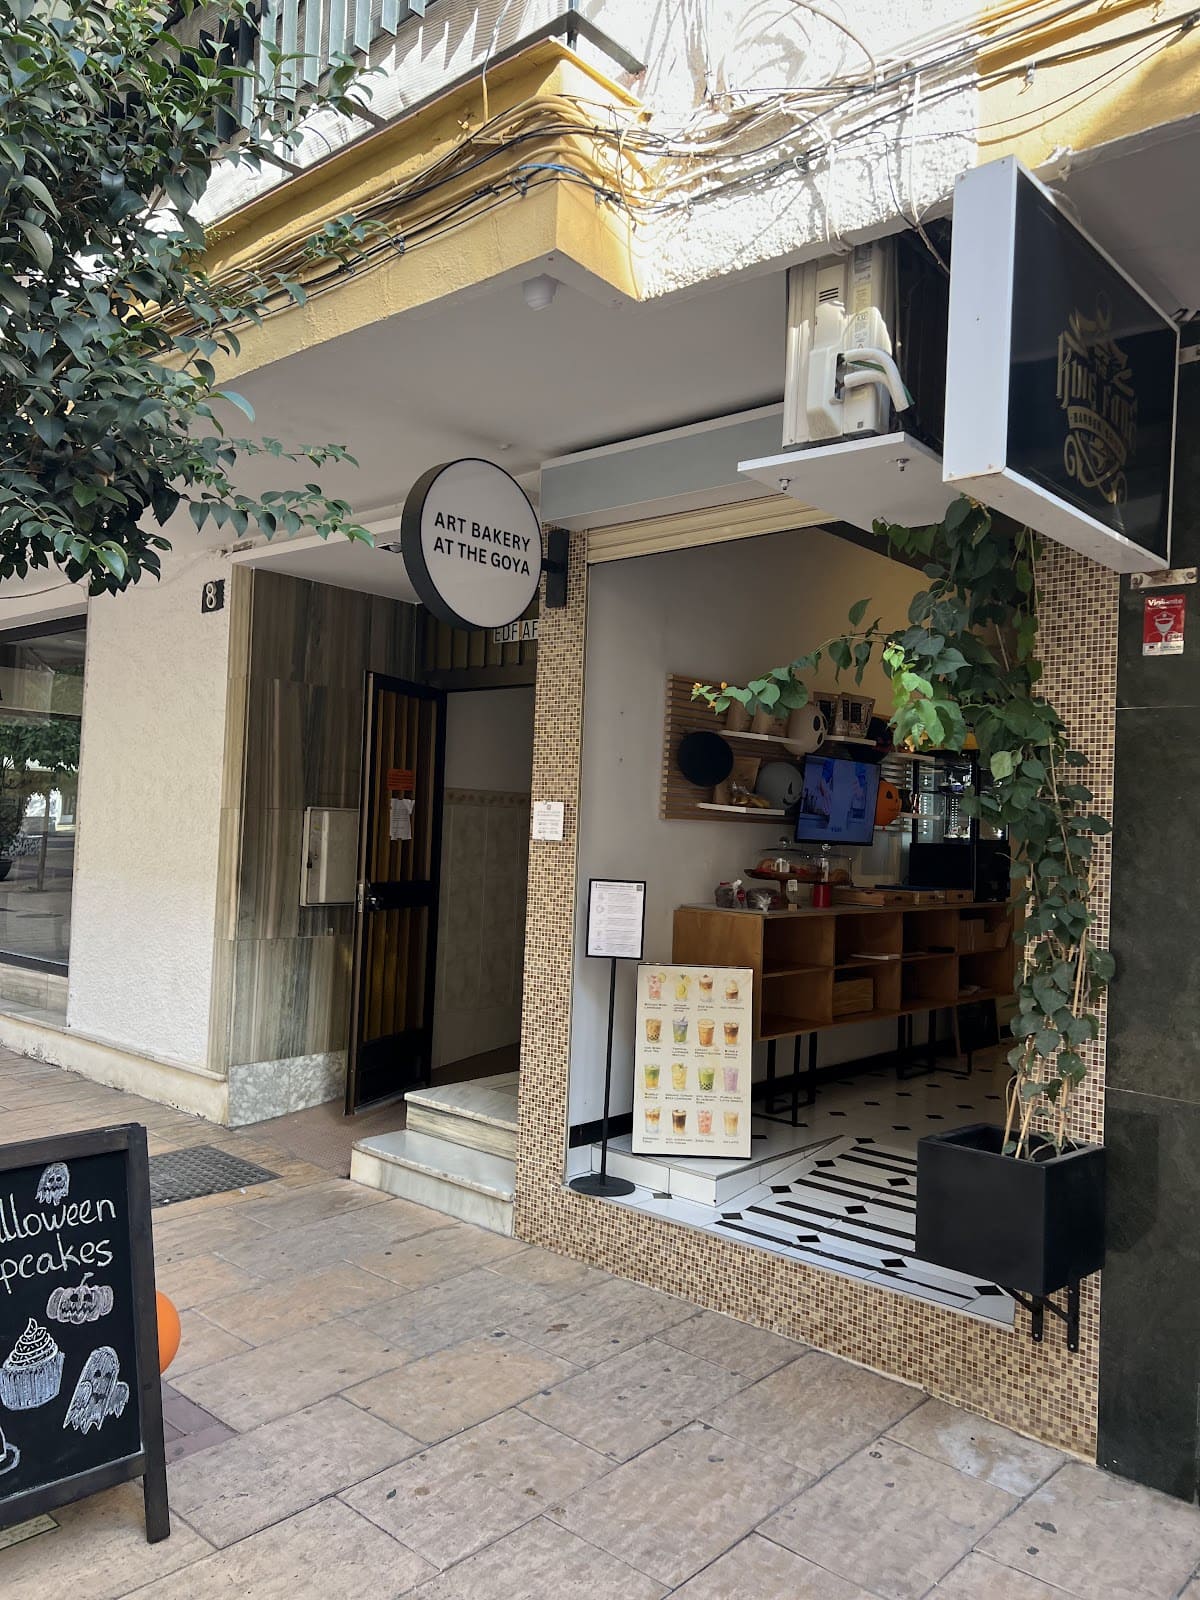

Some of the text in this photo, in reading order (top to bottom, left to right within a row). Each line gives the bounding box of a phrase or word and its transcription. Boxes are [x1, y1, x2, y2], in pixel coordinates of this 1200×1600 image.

[1056, 333, 1097, 412] KING
[1074, 411, 1102, 432] BARBER
[434, 511, 531, 553] ART BAKERY
[433, 536, 530, 577] AT THE GOYA
[206, 583, 217, 609] 8
[0, 1193, 116, 1244] lloween
